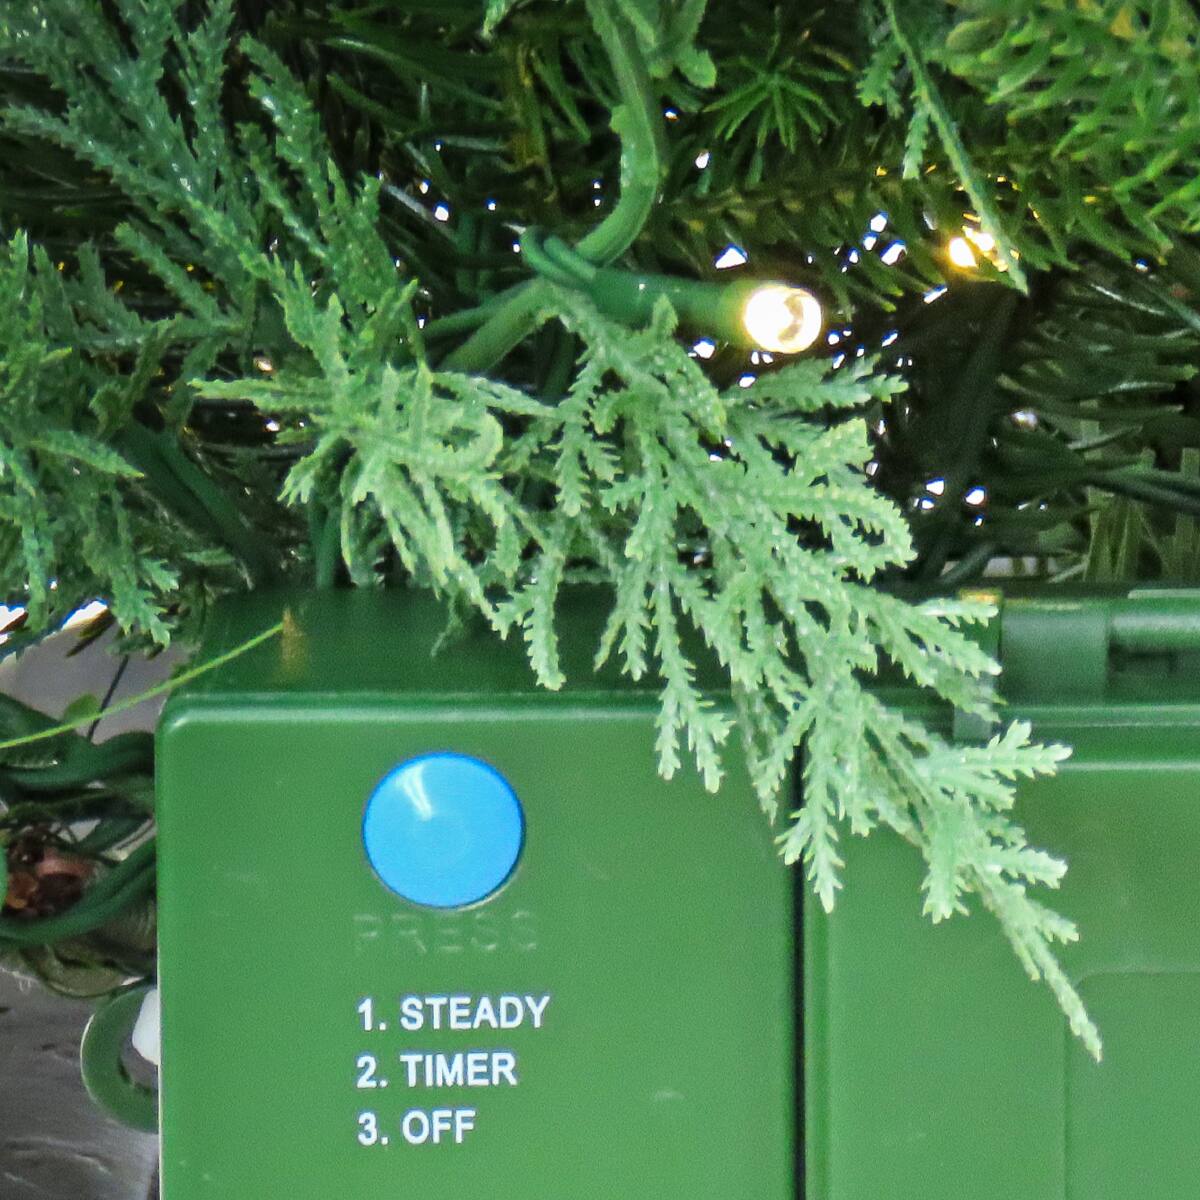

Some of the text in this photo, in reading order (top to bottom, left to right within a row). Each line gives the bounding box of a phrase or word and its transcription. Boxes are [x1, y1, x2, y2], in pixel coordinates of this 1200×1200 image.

[353, 911, 537, 955] PRESS
[357, 996, 550, 1031] 1. STEADY
[356, 1053, 518, 1088] 2. TIMER
[357, 1110, 476, 1146] 3. OFF
